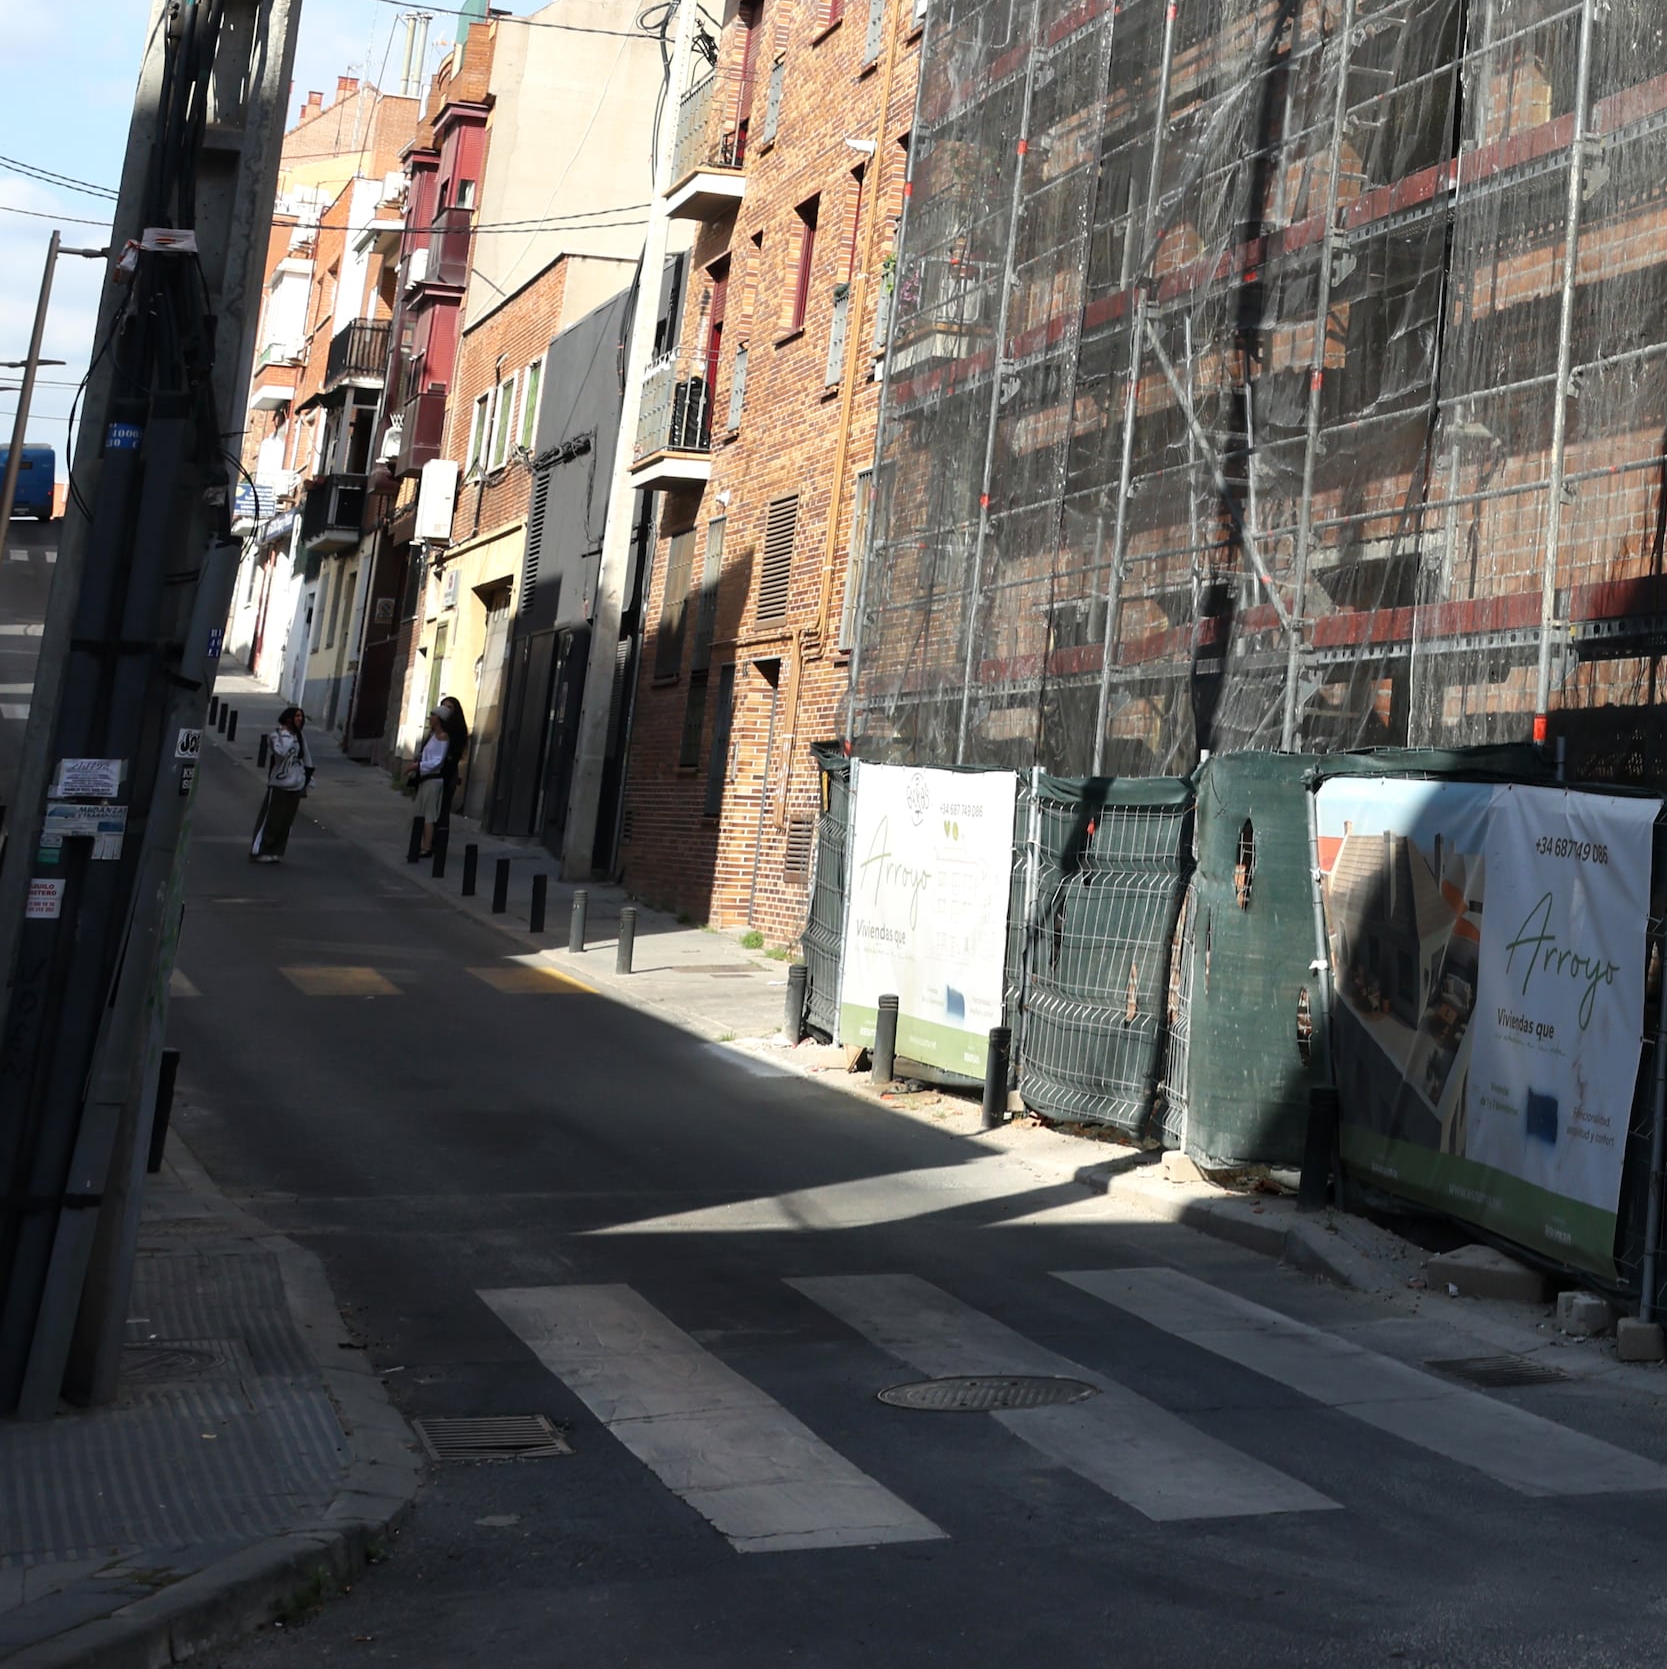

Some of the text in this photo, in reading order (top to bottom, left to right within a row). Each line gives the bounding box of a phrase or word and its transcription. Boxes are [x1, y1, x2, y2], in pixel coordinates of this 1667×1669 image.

[1535, 837, 1553, 855] +34
[1554, 838, 1574, 859] 687
[1592, 843, 1608, 865] 086
[860, 815, 932, 932] Arroyo
[856, 919, 906, 948] Viviendas que
[1505, 892, 1620, 1031] Arroyo
[1497, 1008, 1555, 1041] Viviendas que
